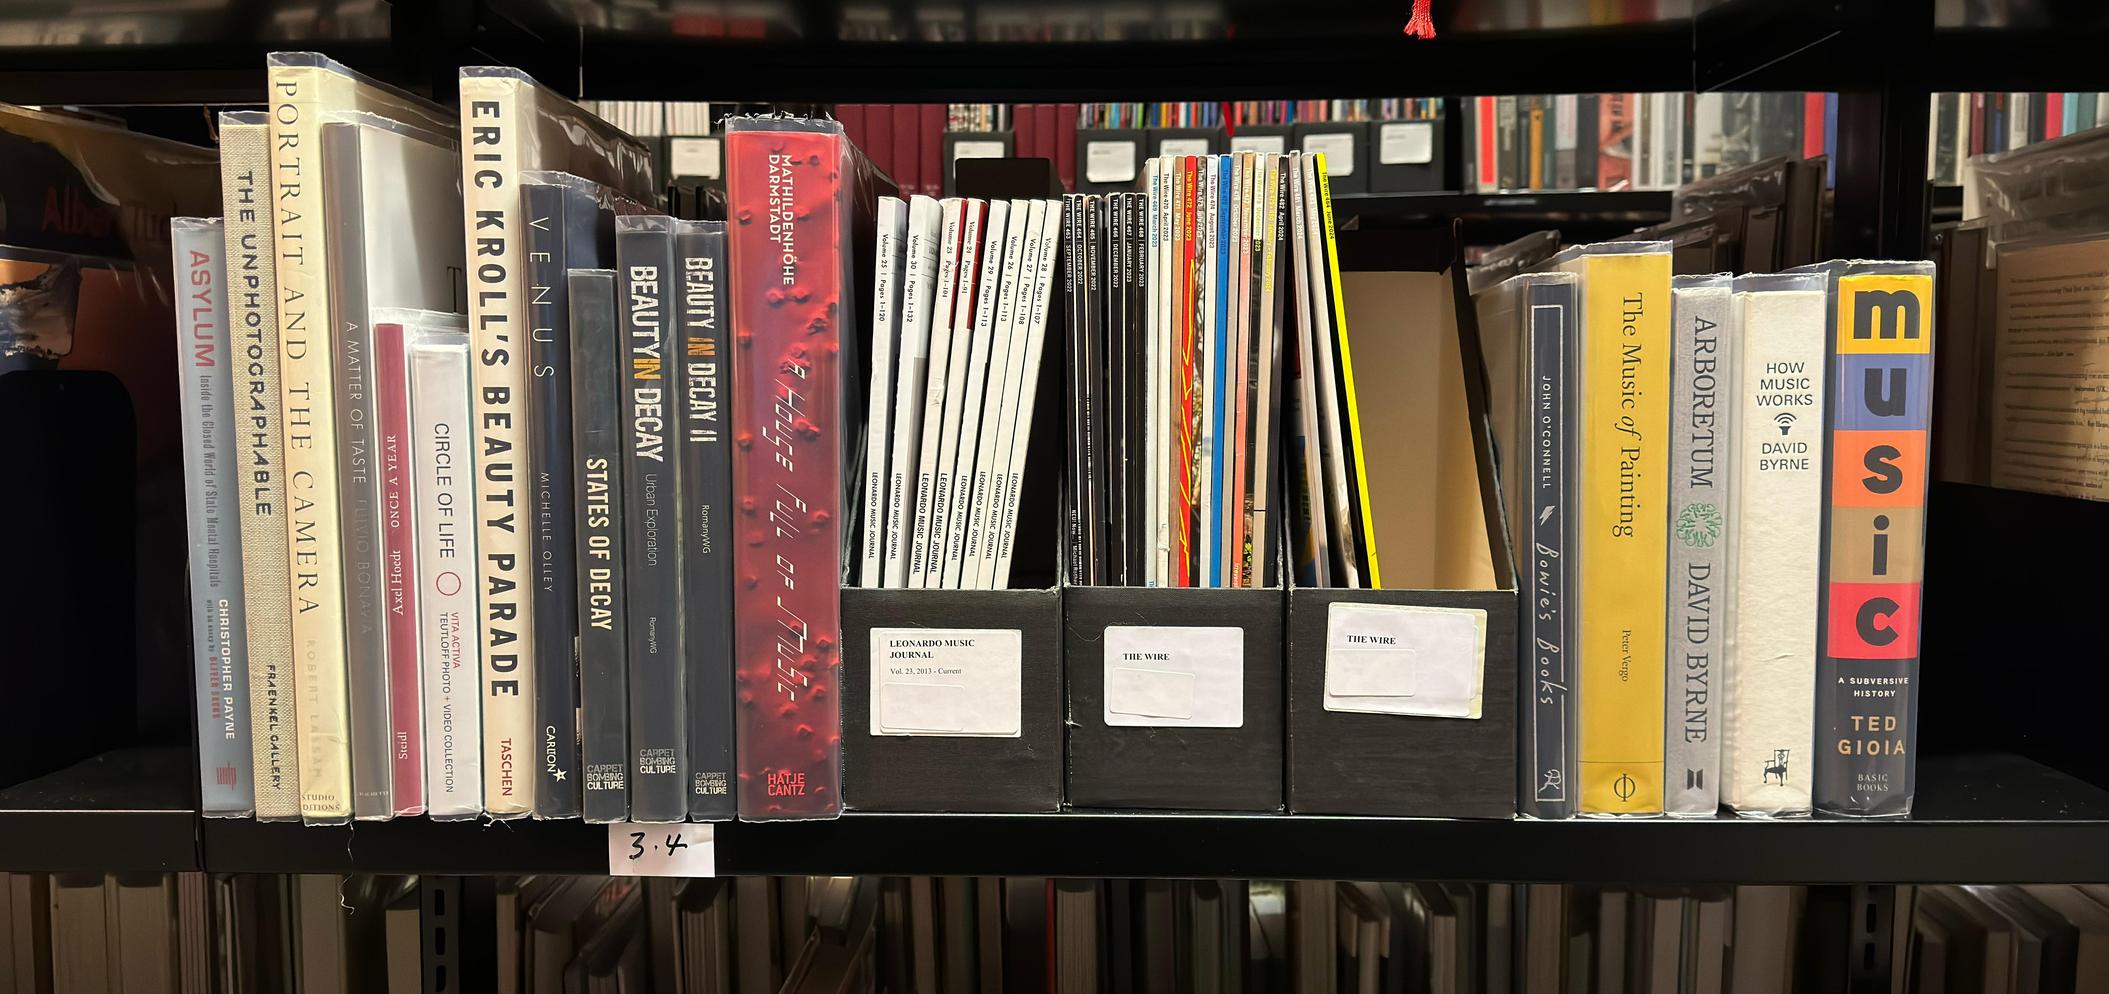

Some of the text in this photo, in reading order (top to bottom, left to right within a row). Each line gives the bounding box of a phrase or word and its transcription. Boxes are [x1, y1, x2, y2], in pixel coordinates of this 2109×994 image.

[769, 154, 781, 243] DARMSTADT
[782, 155, 797, 285] MATHILDENHÖHE
[911, 234, 919, 259] Volume
[882, 259, 888, 268] 25
[911, 261, 917, 269] 30
[529, 217, 555, 377] VENUS
[878, 279, 887, 301] Pages
[907, 279, 916, 301] Pages
[190, 250, 215, 367] ASYLUM
[237, 171, 272, 516] THE UNPHOTOGRAPHABLE
[276, 81, 320, 614] PORTRAIT AND THE CAMERA
[685, 257, 717, 442] BEAUTY IN DECAY II
[787, 359, 806, 379] A
[1766, 362, 1805, 374] HOW
[200, 375, 212, 401] Inside
[1760, 378, 1810, 390] MUSIC
[201, 404, 213, 418] the
[346, 321, 367, 483] A MATTER OF TASTE
[472, 101, 519, 697] ERIC KROLL'S BEAUTY PARADE
[1691, 316, 1718, 489] ARBORETUM
[1756, 394, 1813, 406] WORKS
[634, 388, 664, 463] DECAY
[1612, 292, 1643, 538] The Music of Painting
[202, 421, 215, 449] Closed
[1542, 376, 1552, 489] JOHN O'CONNELL
[1762, 442, 1808, 454] DAVID
[204, 452, 217, 476] World
[1760, 459, 1809, 471] BYRNE
[205, 478, 217, 488] of
[387, 434, 401, 528] ONCE A YEAR
[434, 423, 455, 558] CIRCLE OF LIFE
[645, 474, 658, 566] Urban Exploration
[701, 504, 711, 554] RomanyWG
[913, 473, 930, 574] LEONARDO MUSIC JOURNAL
[930, 473, 948, 574] LEONARDO MUSIC JOURNAL
[1001, 472, 1019, 559] LEONARDO MUSIC JOURNAL
[207, 517, 219, 545] Mental
[540, 472, 553, 592] MICHELLE OLLEY
[586, 458, 612, 630] STATES OF DECAY
[207, 548, 222, 588] Hospitals
[390, 549, 403, 616] Axel Hoedt
[440, 612, 450, 659] TEUTLOFF
[649, 617, 657, 654] RomanyWG
[1536, 542, 1568, 705] Bowie's Books
[450, 612, 461, 669] VITA ACTIVA
[889, 639, 975, 648] LEONARDO MUSIC
[1347, 634, 1396, 645] THE WIRE
[1685, 563, 1710, 743] DAVID BYRNE
[889, 651, 934, 659] JOURNAL
[1122, 653, 1170, 661] THE WIRE
[1618, 630, 1631, 682] Peter Vergo
[219, 599, 235, 740] CHRISTOPHER PAYNE
[442, 661, 451, 694] PHOTO
[890, 667, 903, 675] Vol.
[905, 667, 916, 676] 23,
[916, 667, 932, 675] 2013
[938, 667, 962, 675] Current
[1850, 677, 1909, 685] SUBVERSIVE
[268, 664, 281, 790] FRAENKEL GALLERY
[443, 704, 452, 730] VIDEO
[1851, 716, 1897, 731] TED
[396, 731, 408, 759] Steidl
[546, 725, 557, 773] CARLTON
[640, 749, 675, 757] CARPET
[1838, 739, 1905, 755] GIOIA
[443, 732, 454, 793] COLLECTION
[501, 738, 513, 797] TASCHEN
[587, 764, 624, 773] CARPET
[640, 757, 676, 765] BOMBING
[640, 765, 676, 774] CULTURE
[587, 773, 624, 781] BOMBING
[587, 781, 624, 790] CULTURE
[695, 772, 727, 780] CARPET
[768, 773, 805, 785] HATJE
[1858, 774, 1888, 782] BASIC
[302, 794, 336, 802] STUDIO
[695, 787, 727, 795] CULTURE
[768, 785, 805, 796] CANTZ
[302, 803, 341, 811] DITIONS
